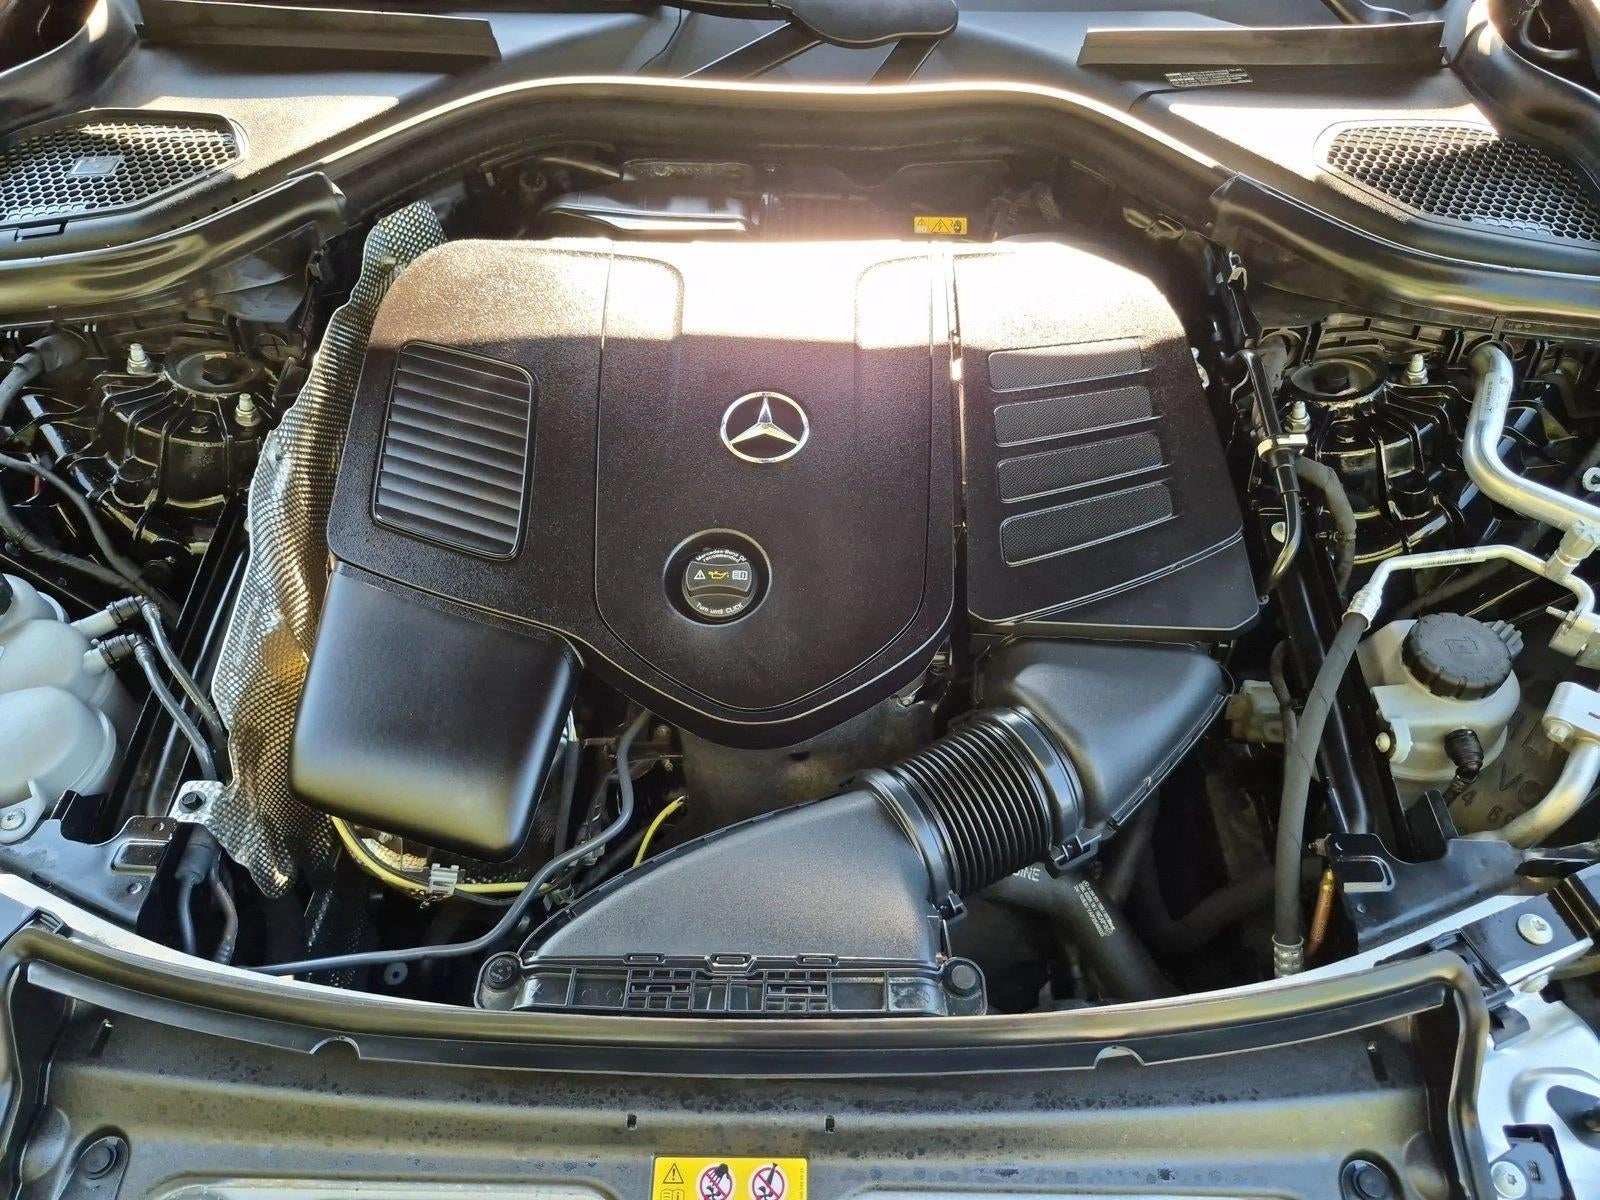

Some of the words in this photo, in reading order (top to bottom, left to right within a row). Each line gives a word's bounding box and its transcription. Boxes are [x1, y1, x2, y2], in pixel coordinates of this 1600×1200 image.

[703, 554, 740, 563] recommended
[696, 602, 709, 612] Turn
[725, 602, 744, 614] CLICK
